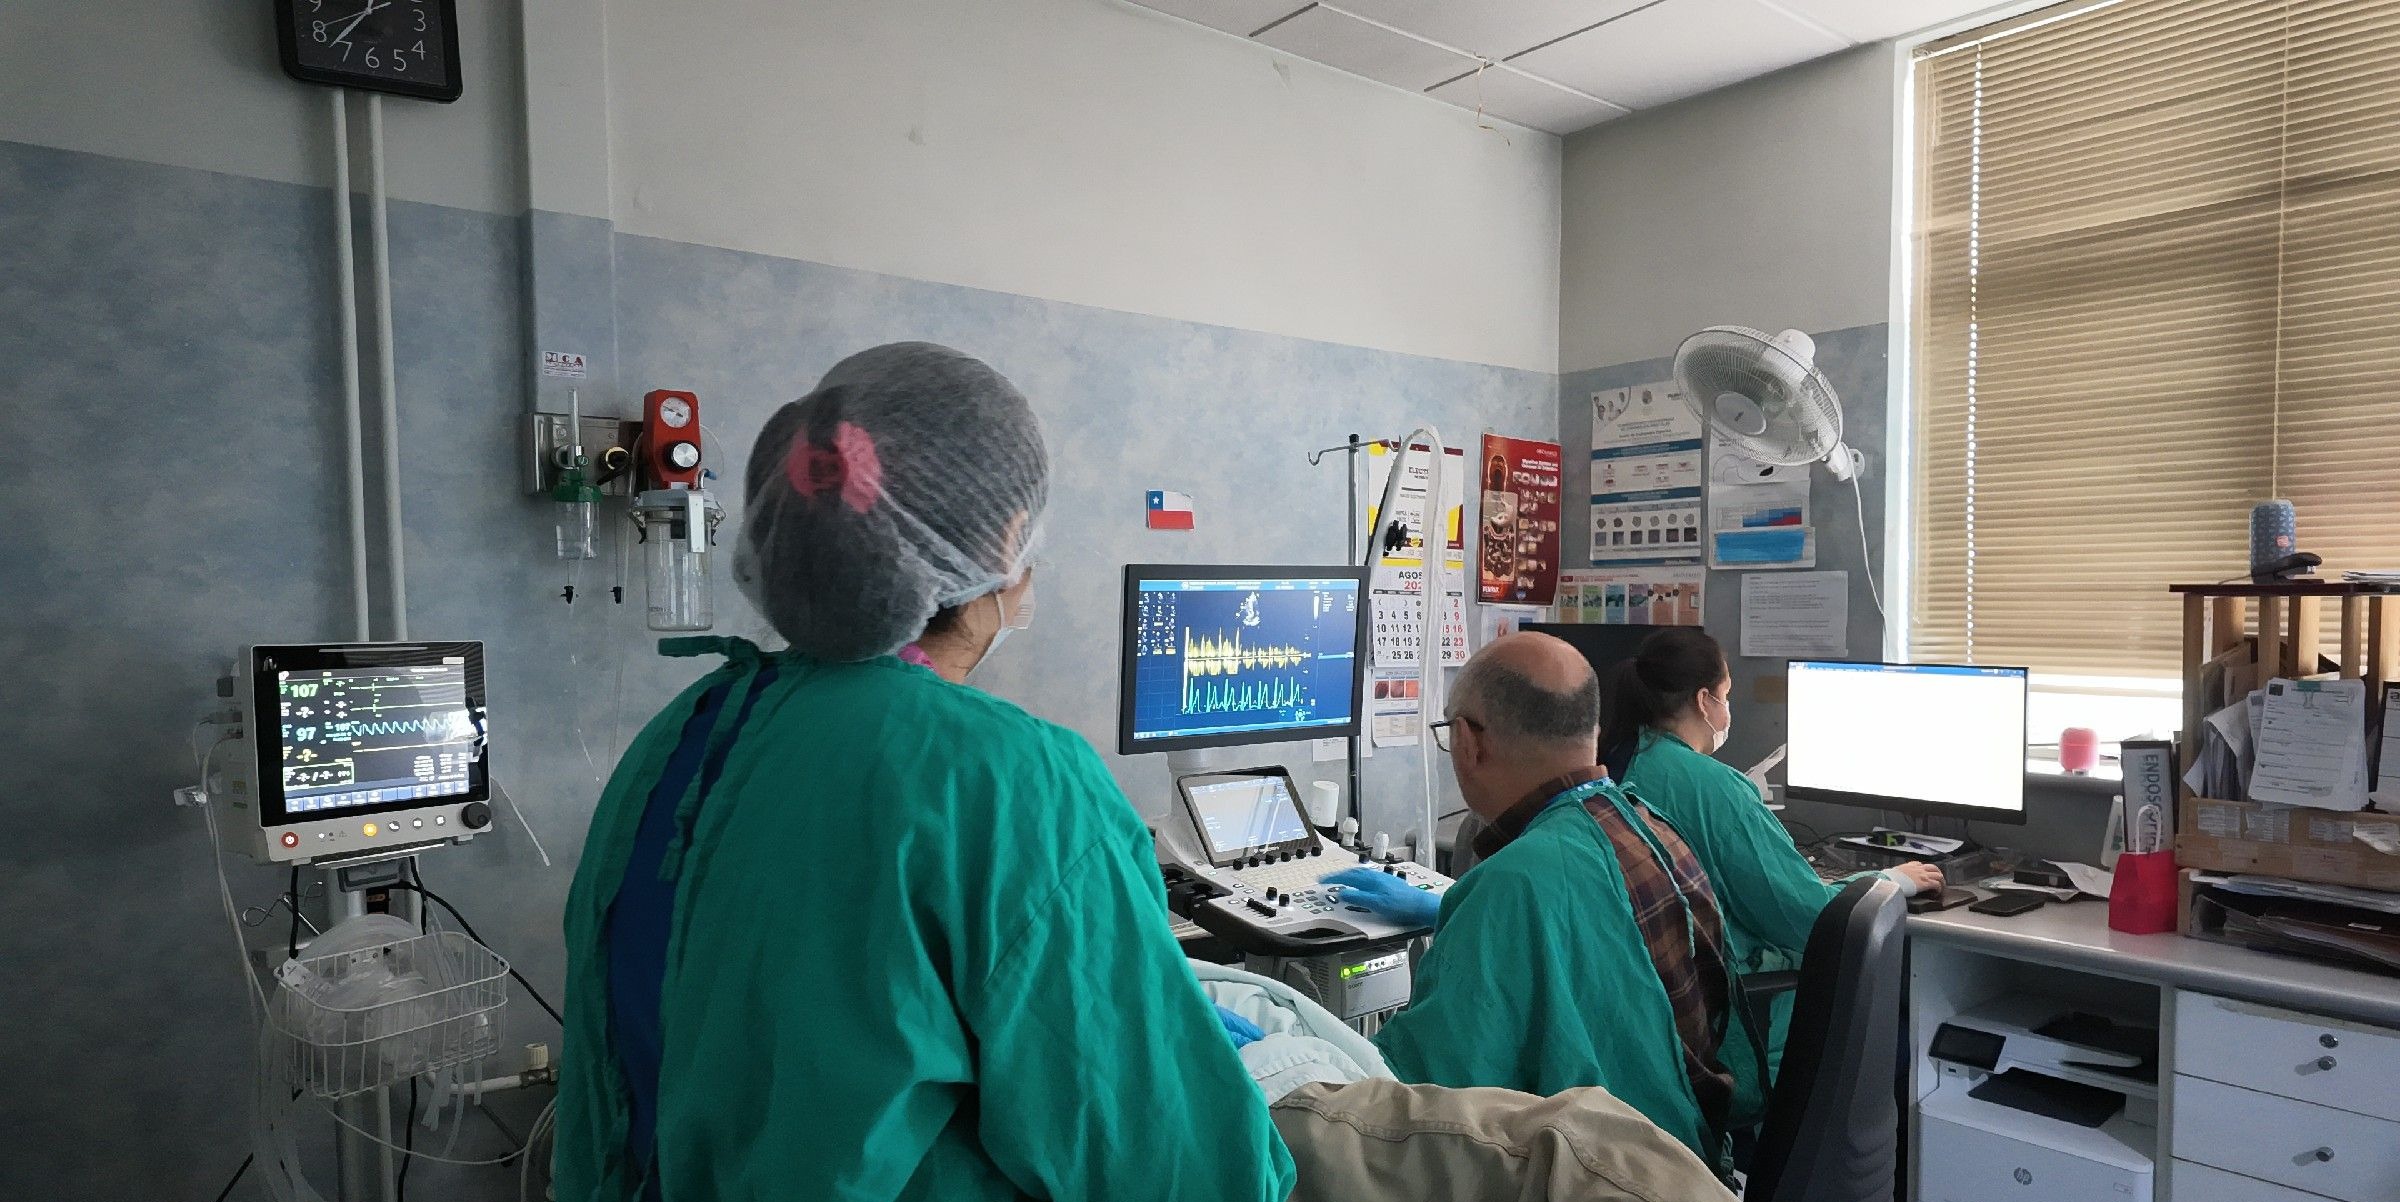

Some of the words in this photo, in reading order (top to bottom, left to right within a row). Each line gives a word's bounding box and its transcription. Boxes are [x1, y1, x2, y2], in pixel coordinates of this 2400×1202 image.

[412, 9, 426, 32] 3
[312, 20, 328, 43] 8
[334, 40, 353, 63] 7
[365, 47, 380, 69] 6
[411, 40, 427, 61] 4
[393, 49, 407, 72] 5
[1453, 598, 1459, 608] 2
[1378, 610, 1384, 620] 3
[1391, 610, 1396, 620] 4
[1403, 610, 1409, 620] 5
[1416, 611, 1422, 620] 6
[1453, 611, 1460, 621] 9
[1376, 623, 1387, 633] 10
[1390, 623, 1400, 633] 11
[1402, 623, 1412, 633] 12
[1452, 624, 1463, 633] 16
[1376, 636, 1387, 646] 17
[1390, 636, 1400, 646] 18
[1402, 636, 1413, 646] 19
[1441, 636, 1451, 646] 22
[1453, 637, 1464, 646] 23
[1391, 650, 1402, 660] 25
[1403, 650, 1414, 660] 26
[1441, 650, 1452, 659] 29
[1454, 651, 1466, 659] 30
[290, 683, 319, 698] 107
[295, 726, 317, 742] 97
